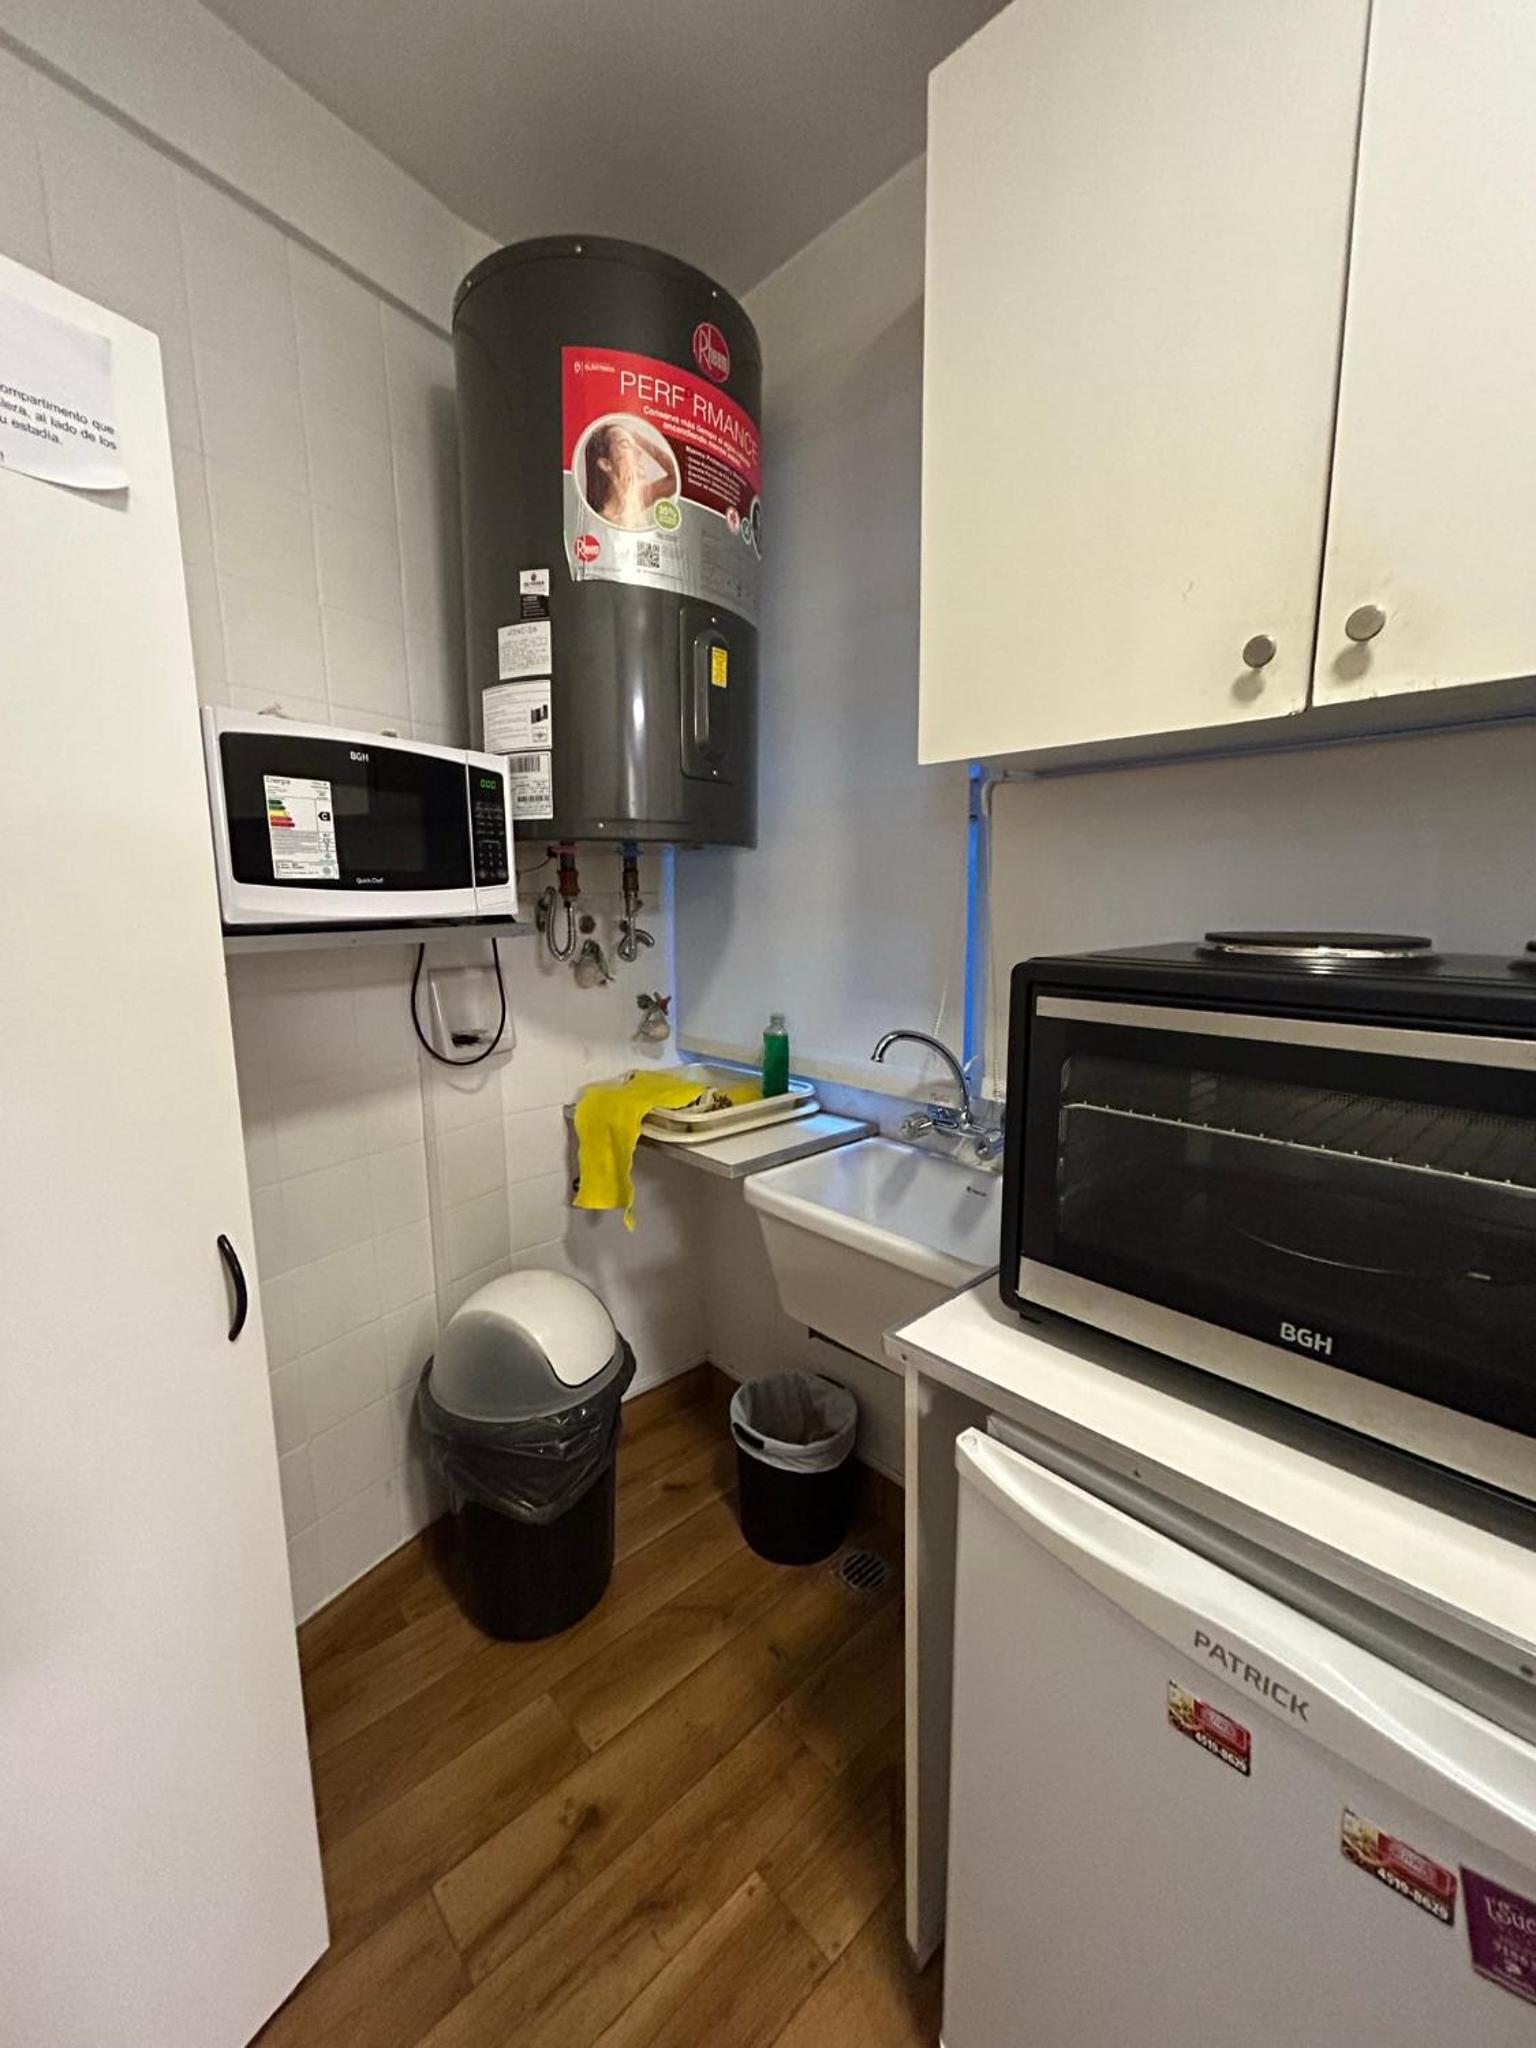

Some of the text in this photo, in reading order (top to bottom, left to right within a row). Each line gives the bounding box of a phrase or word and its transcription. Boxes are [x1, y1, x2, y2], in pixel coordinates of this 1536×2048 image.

[0, 384, 115, 435] ompartimento que
[35, 412, 47, 424] al
[50, 416, 78, 435] lado
[80, 429, 96, 442] de
[99, 435, 117, 450] los
[350, 751, 369, 762] BGH
[1280, 1322, 1333, 1355] BGH
[1194, 1630, 1309, 1722] PATRICK
